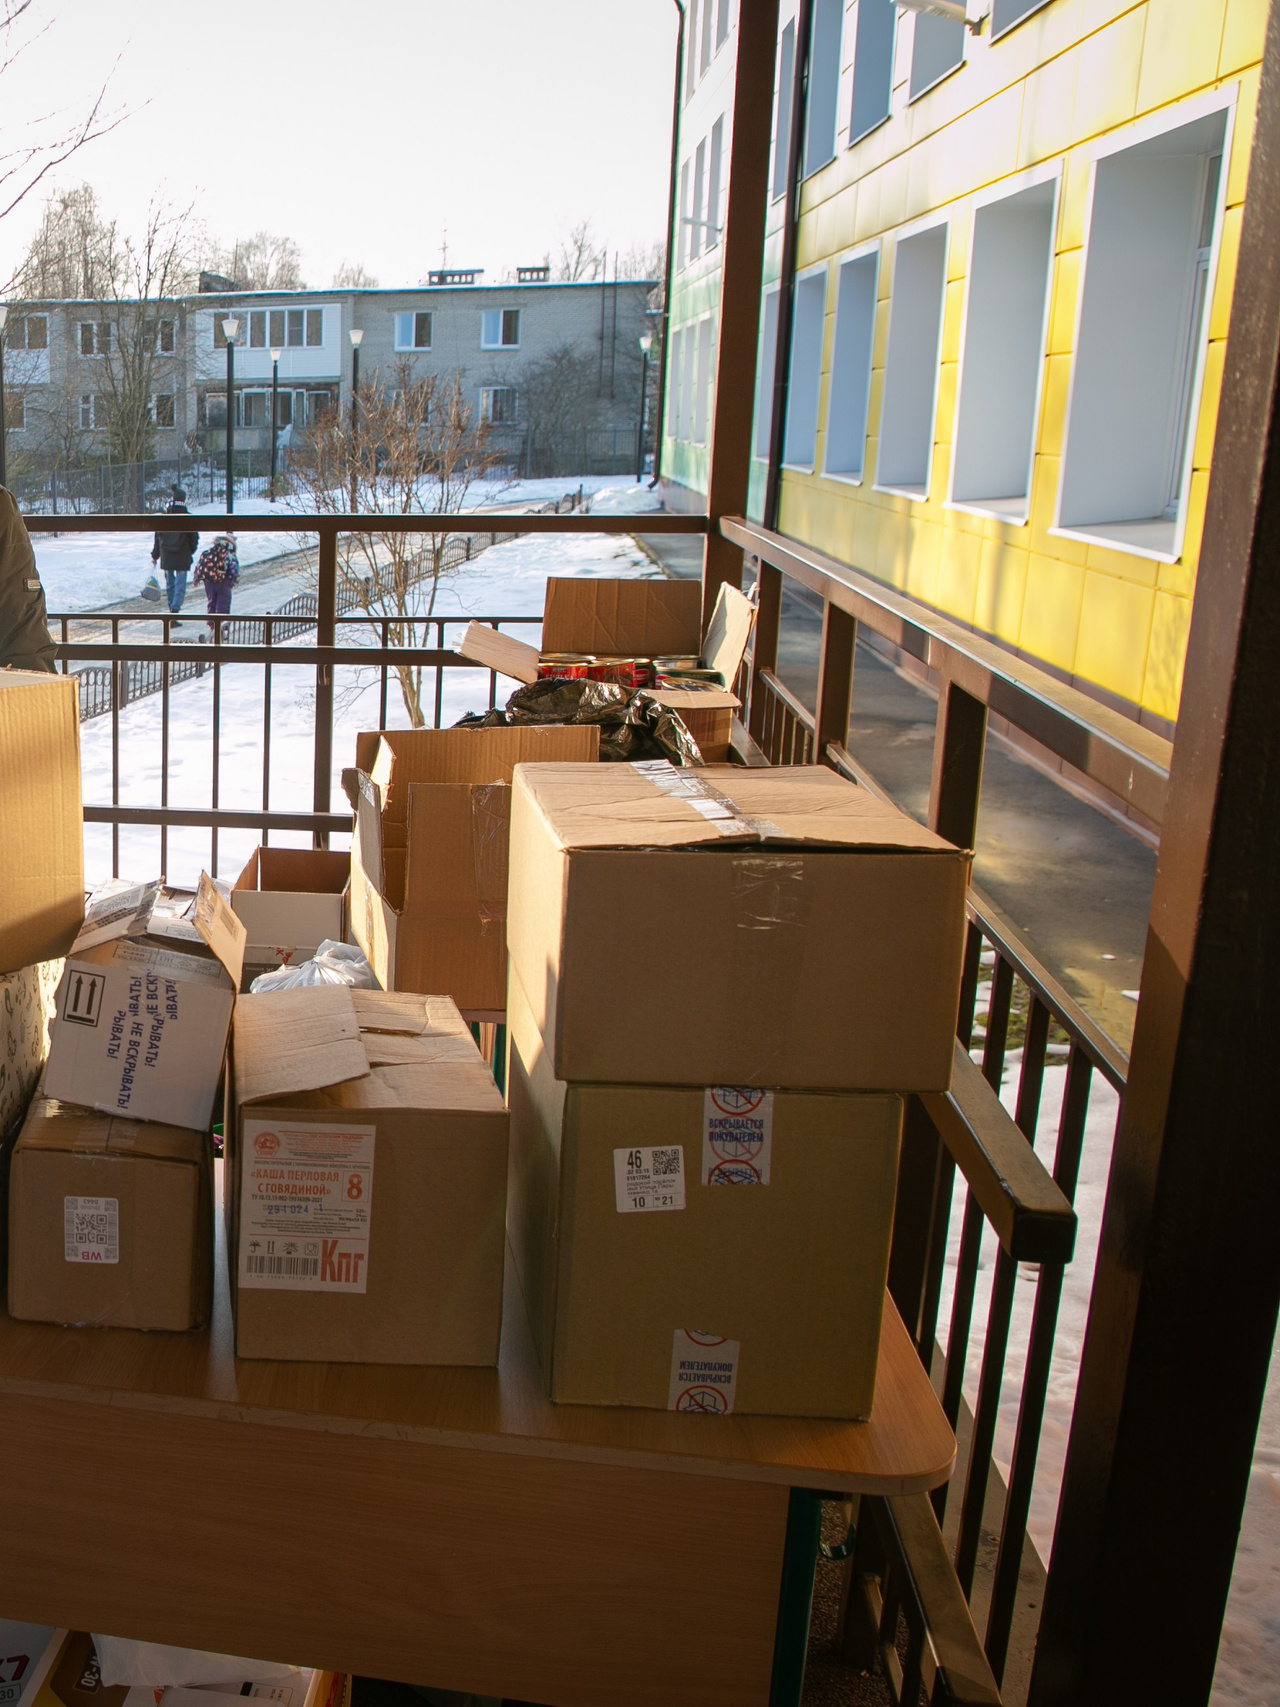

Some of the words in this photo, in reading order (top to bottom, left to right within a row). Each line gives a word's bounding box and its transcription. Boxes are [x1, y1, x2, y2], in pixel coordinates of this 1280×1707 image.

[130, 1021, 145, 1038] НЕ
[117, 1039, 142, 1110] ВСКРЫВАТЬ!
[708, 1118, 765, 1130] ВСКРЫВАЕТСЯ
[708, 1131, 765, 1143] ПОКУПАТЕЛЕМ
[627, 1150, 642, 1169] 46
[250, 1168, 286, 1181] «КАША
[287, 1170, 340, 1182] ПЕРЛОВАЯ
[257, 1183, 264, 1194] С
[265, 1183, 332, 1196] ГОВЯДИНОЙ»
[346, 1172, 363, 1200] 8
[632, 1196, 646, 1208] 10
[661, 1195, 674, 1206] 21
[81, 1251, 103, 1261] WB
[320, 1239, 365, 1284] Кпг
[679, 1360, 733, 1373] ПОКУПАТЕЛЕМ
[678, 1372, 732, 1384] ВСКРЫВАЕТСЯ
